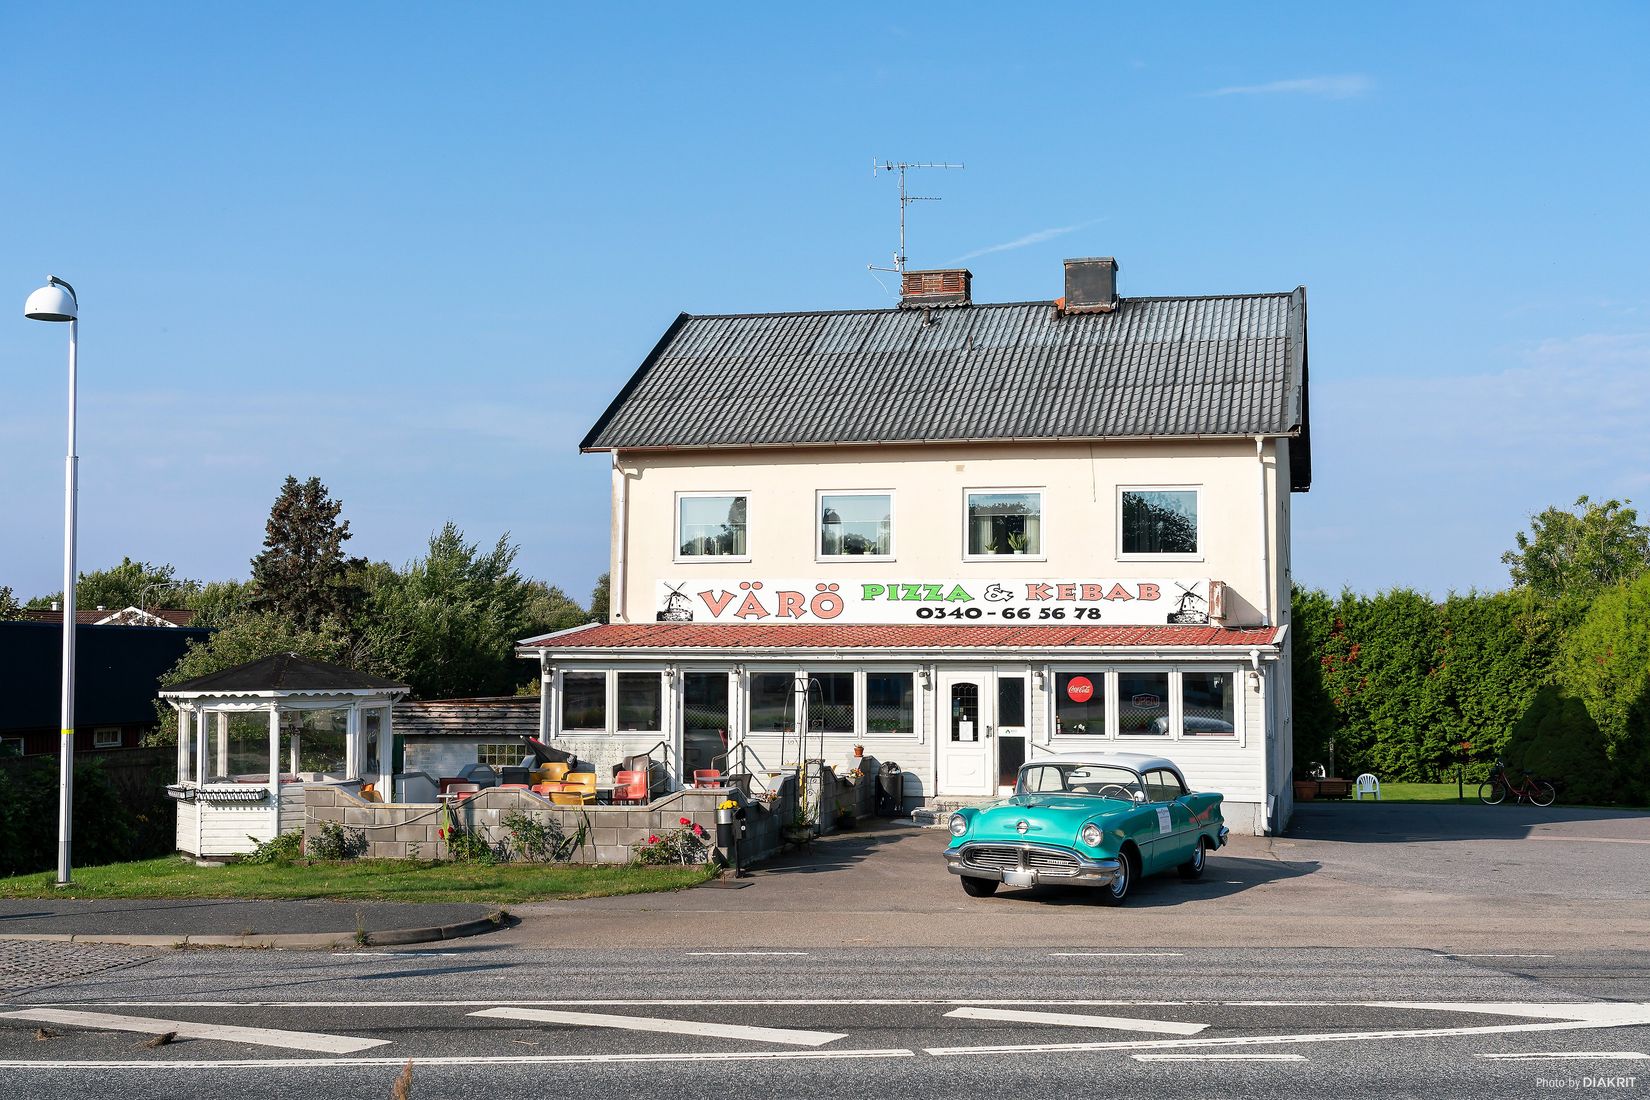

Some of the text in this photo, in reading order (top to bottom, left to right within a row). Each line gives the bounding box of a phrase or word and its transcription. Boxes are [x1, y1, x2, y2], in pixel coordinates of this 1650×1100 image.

[697, 581, 1161, 620] VÄRÖ PIZZA & KEBAB
[916, 607, 983, 620] 0340
[1001, 607, 1031, 620] 66
[1038, 607, 1066, 620] 56
[1074, 607, 1102, 620] 78
[1134, 696, 1158, 706] OPEN
